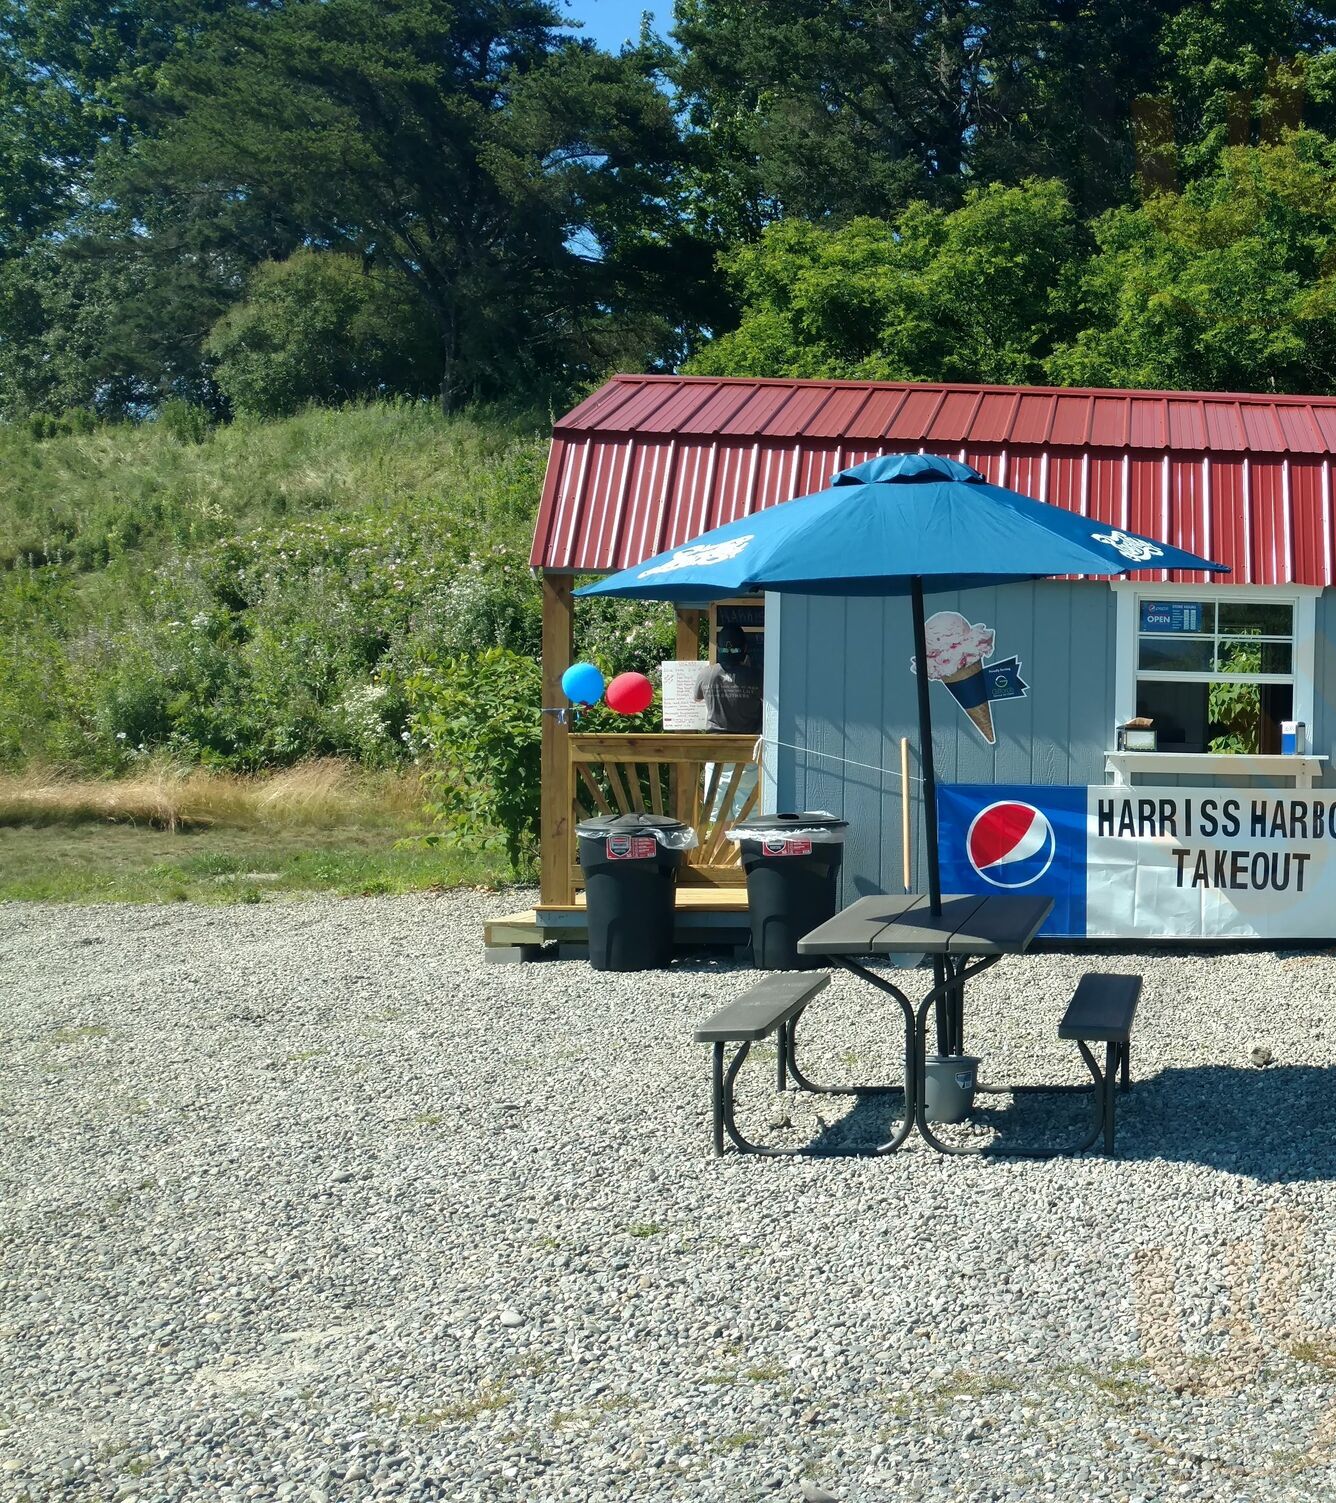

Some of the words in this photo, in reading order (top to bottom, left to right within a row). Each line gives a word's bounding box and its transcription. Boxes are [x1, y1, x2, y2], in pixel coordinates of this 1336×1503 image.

[1147, 615, 1170, 623] OPEN
[1098, 798, 1240, 838] HARRISS
[1172, 848, 1311, 892] TAKEOUT
